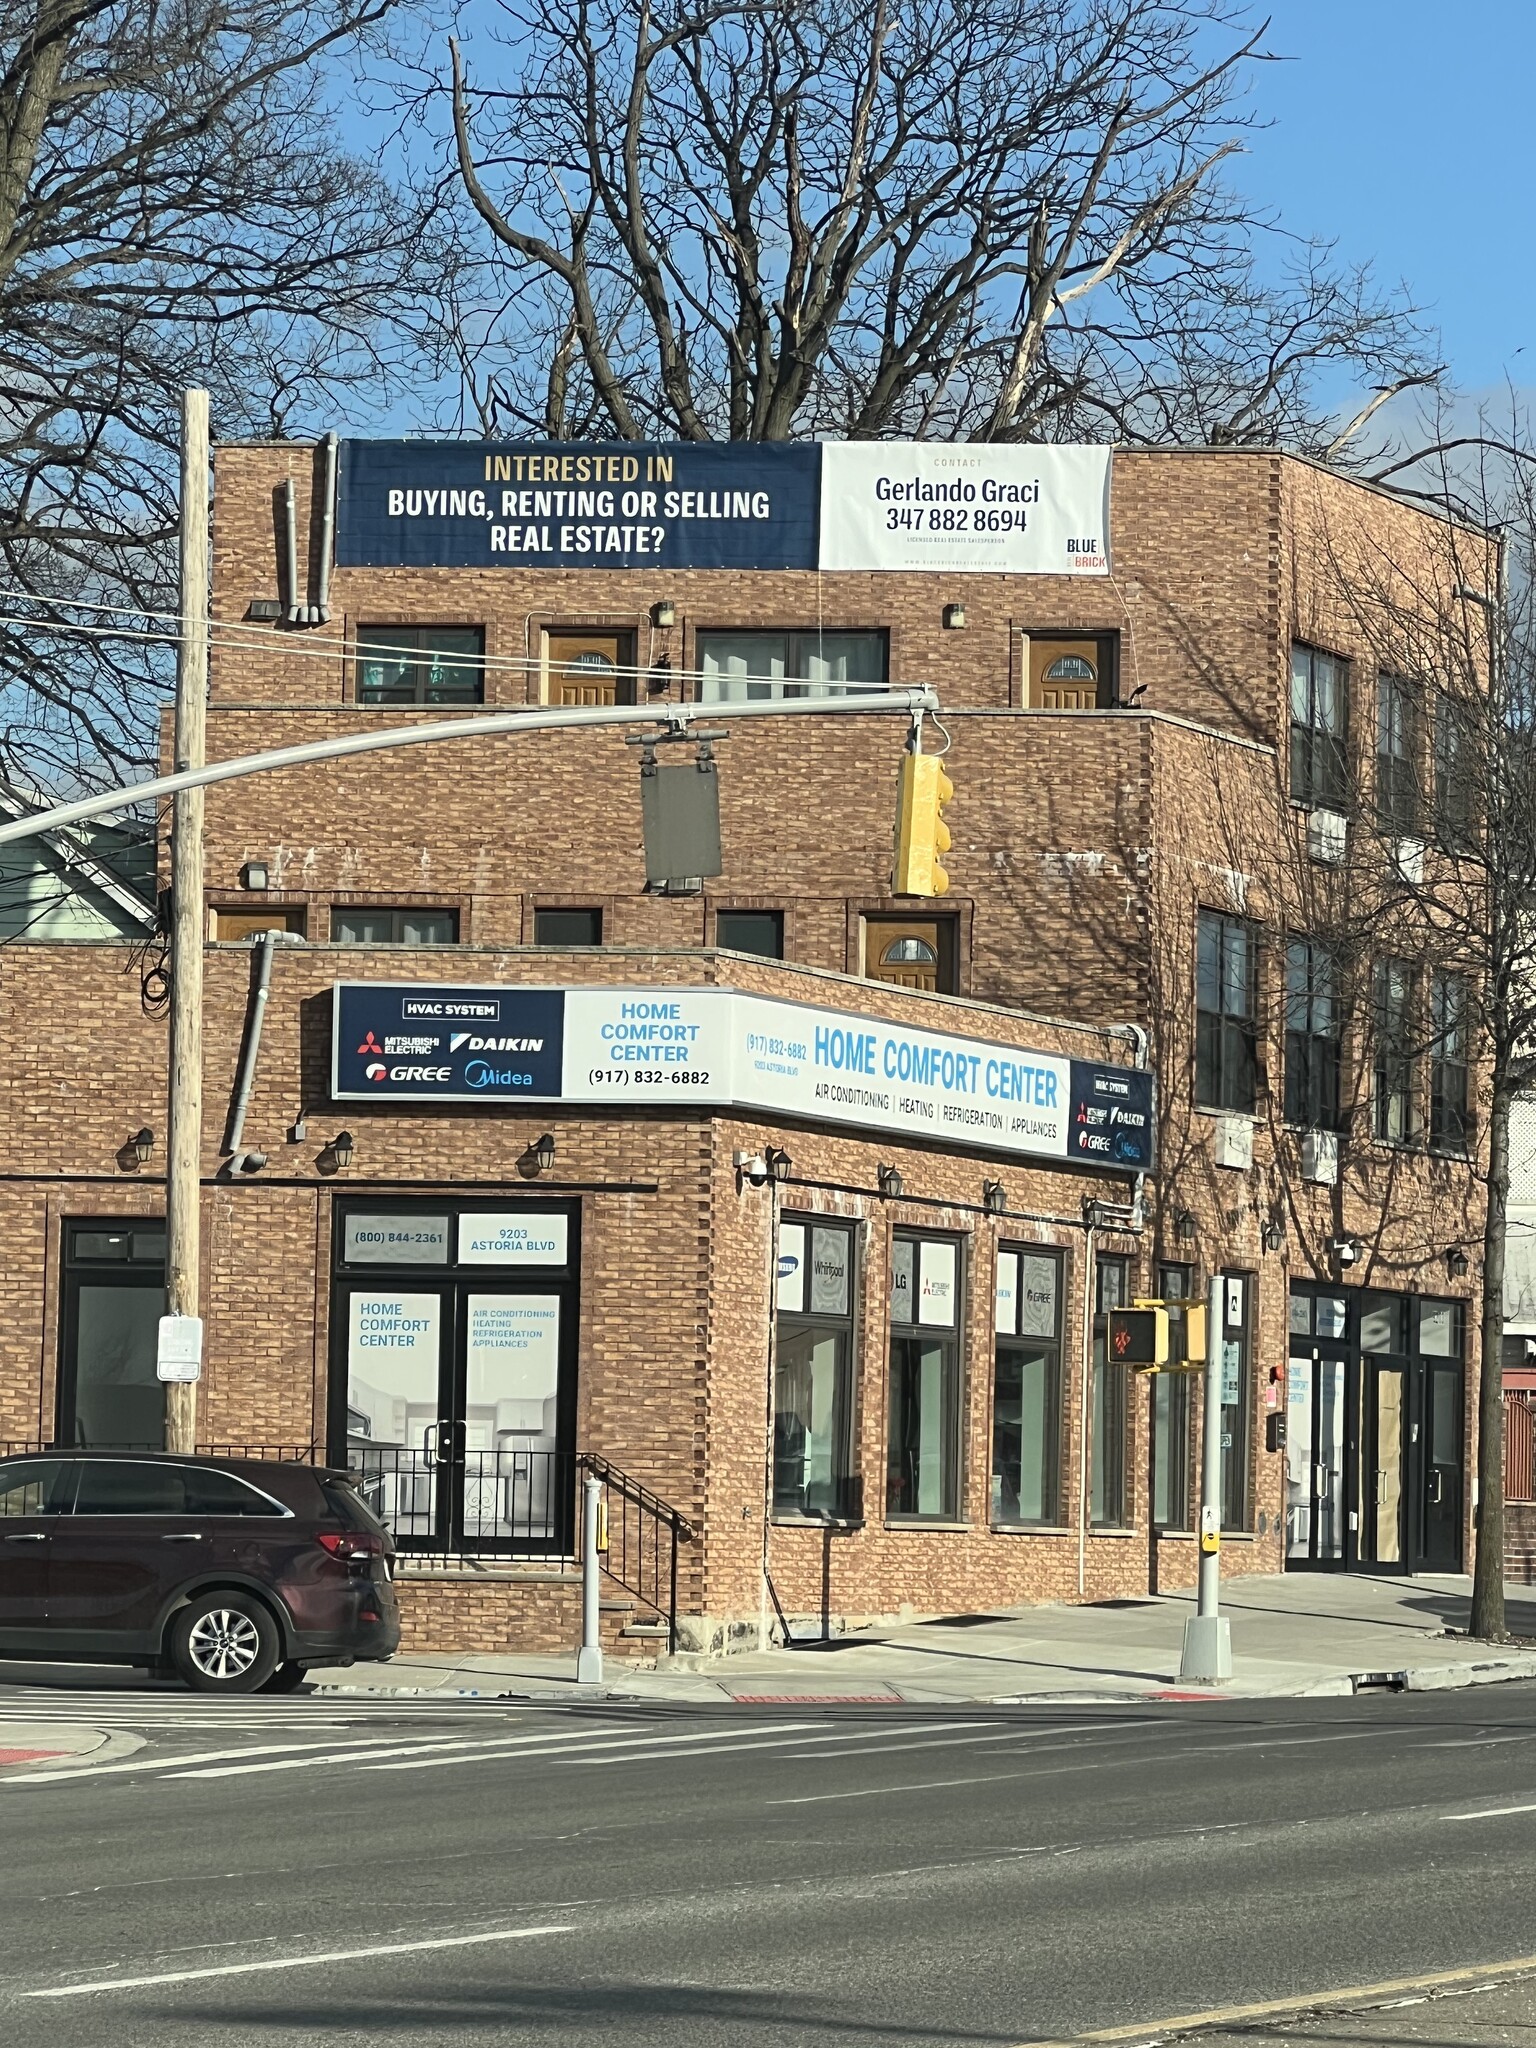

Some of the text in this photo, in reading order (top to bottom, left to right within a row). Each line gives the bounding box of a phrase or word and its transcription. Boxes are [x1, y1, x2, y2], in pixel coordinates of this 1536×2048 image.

[485, 455, 673, 483] INTERESTED IN
[934, 458, 981, 467] CONTACT
[875, 477, 1039, 503] Gerlando Graci
[388, 490, 769, 521] BUYING, RENTING OR SELLING
[886, 508, 1027, 532] 347 882 8694
[490, 525, 665, 553] REAL ESTATE?
[1067, 538, 1097, 553] BLUE
[1075, 556, 1105, 567] BRICK
[407, 1003, 495, 1016] HVAC SYSTEM
[621, 1003, 681, 1020] HOME
[601, 1023, 700, 1041] COMFORT
[384, 1036, 440, 1046] MITSUBISHI
[469, 1037, 544, 1051] DAIKIN
[747, 1033, 806, 1060] (917) 832-6882
[384, 1045, 432, 1055] ELECTRIC
[610, 1045, 689, 1062] CENTER
[390, 1066, 452, 1081] GREE
[815, 1025, 1058, 1108] HOME COMFORT CENTER
[469, 1063, 533, 1087] Midea
[588, 1069, 710, 1086] (917) 832-6882
[815, 1082, 1057, 1139] AIR CONDITIONING HEATING REFRIGERATION APPLIANCES
[1088, 1135, 1111, 1151] GREE
[355, 1232, 443, 1244] (800) 844-2361
[499, 1229, 528, 1239] 9203
[471, 1240, 556, 1251] ASTORIA BLVD
[895, 1273, 906, 1289] LG
[360, 1303, 403, 1315] HOME
[473, 1310, 556, 1318] AIR CONDITIONING
[360, 1319, 430, 1331] COMFORT
[473, 1319, 511, 1327] HEATING
[360, 1335, 415, 1347] CENTER
[473, 1330, 543, 1338] REFRIGERATION
[473, 1340, 528, 1348] APPLIANCES
